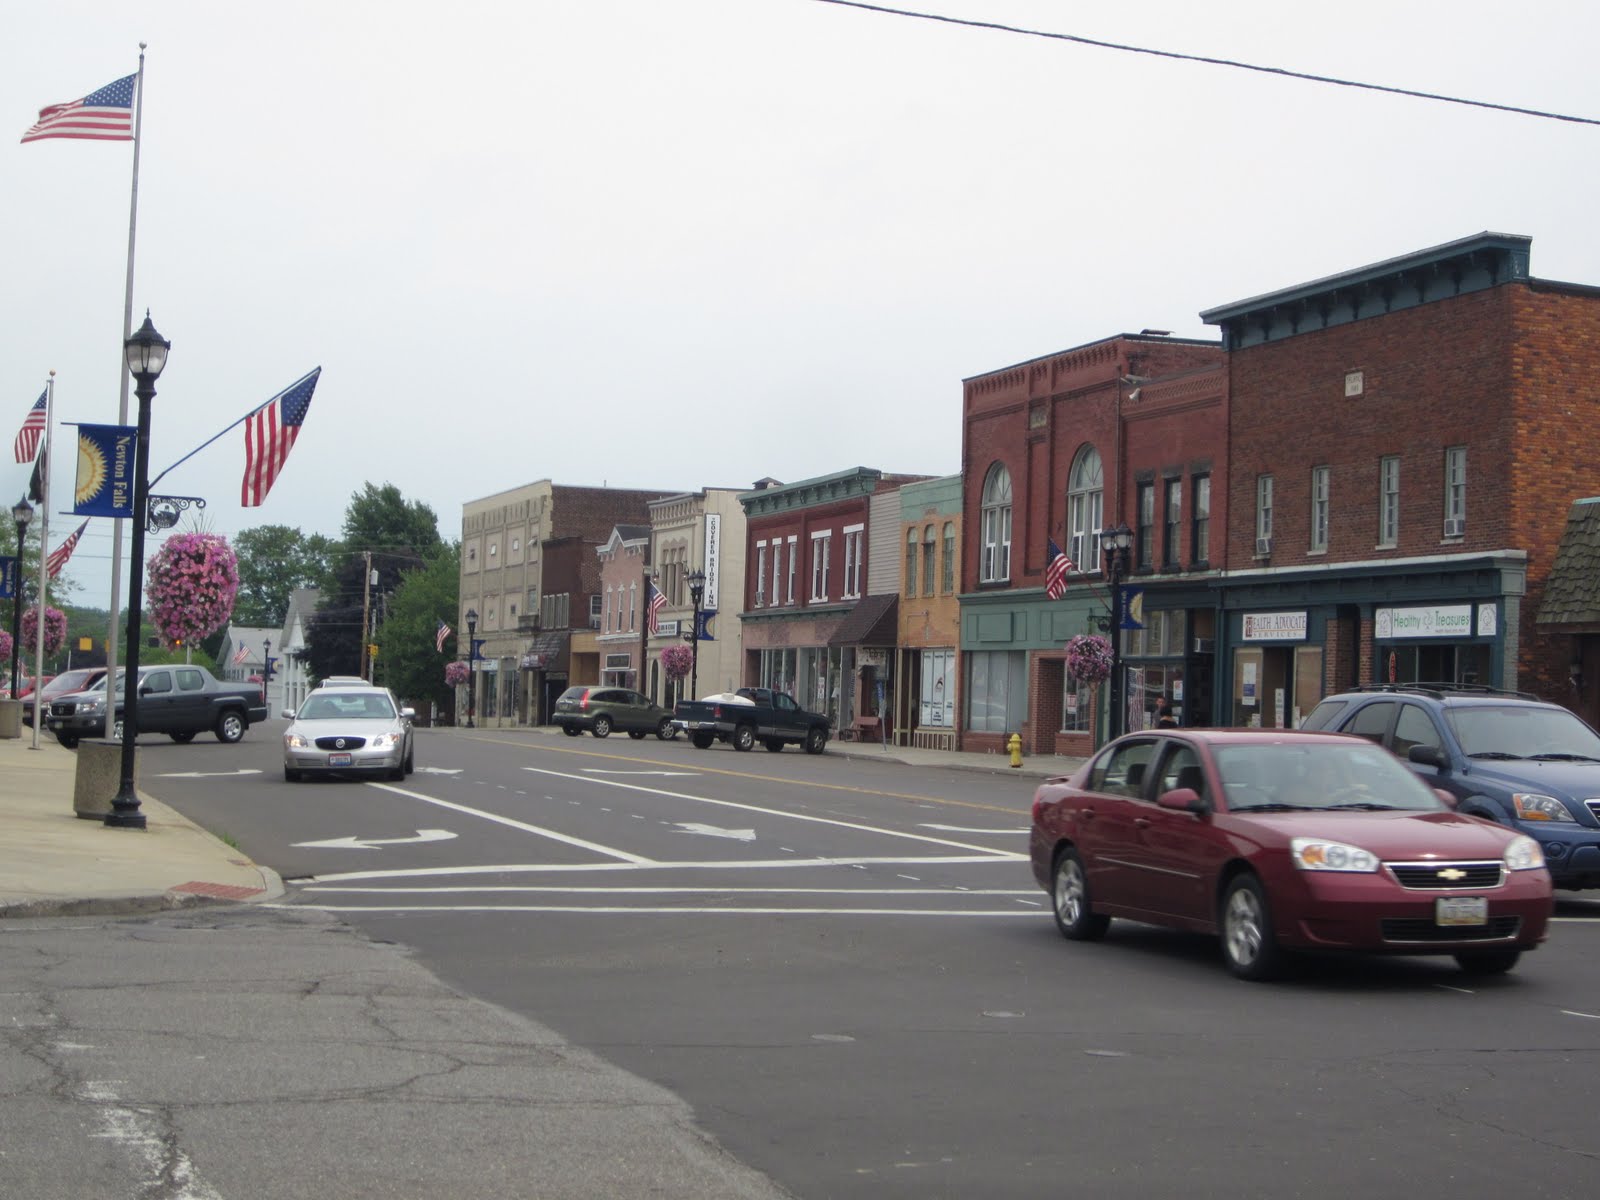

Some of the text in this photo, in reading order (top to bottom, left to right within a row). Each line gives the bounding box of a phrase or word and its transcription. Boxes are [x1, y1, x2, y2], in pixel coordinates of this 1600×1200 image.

[113, 436, 131, 508] Newton Falls
[1275, 615, 1307, 629] ADVOCATE
[1393, 612, 1420, 630] Healthy
[1435, 610, 1470, 627] Treasures
